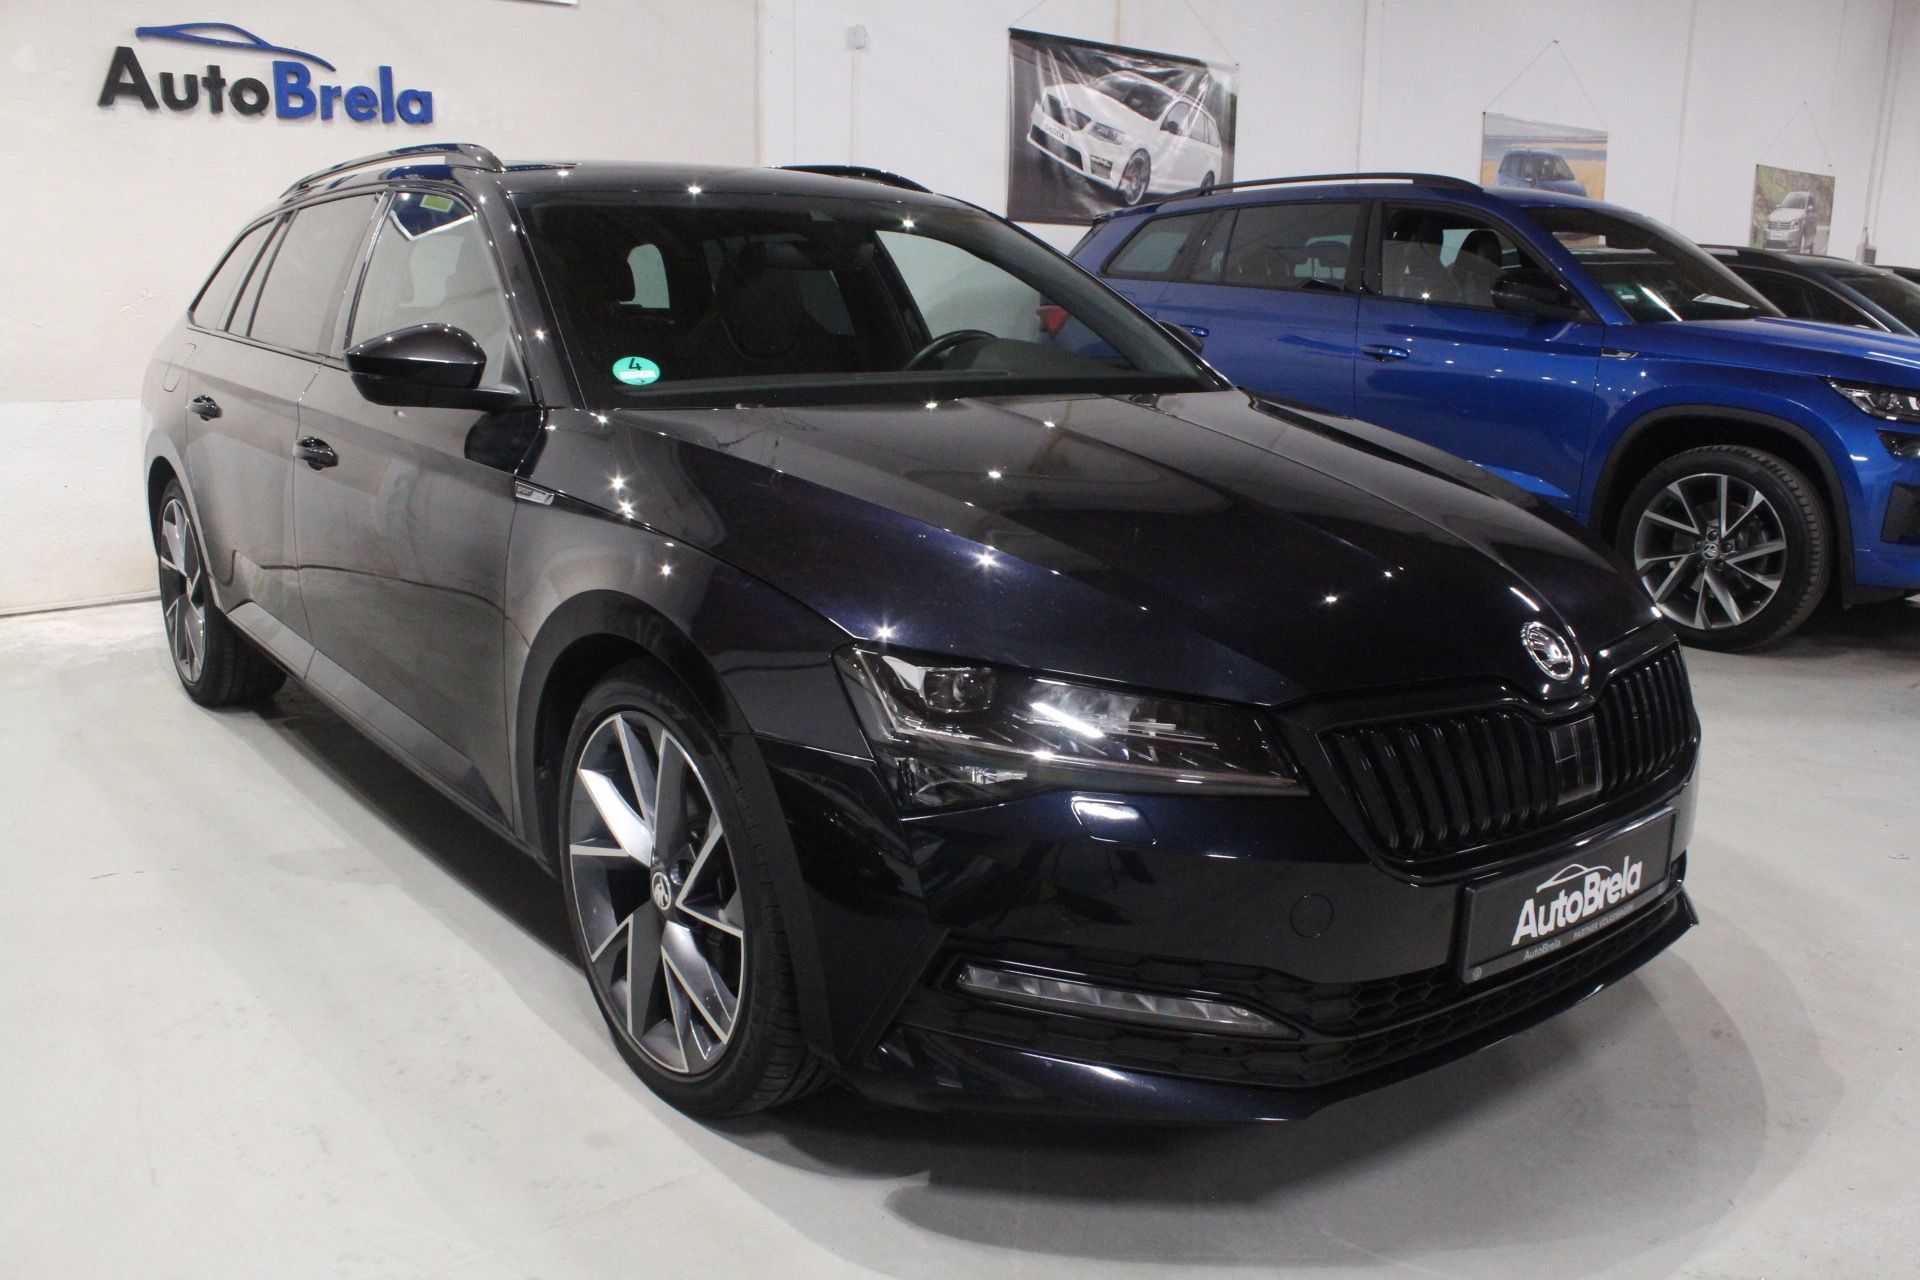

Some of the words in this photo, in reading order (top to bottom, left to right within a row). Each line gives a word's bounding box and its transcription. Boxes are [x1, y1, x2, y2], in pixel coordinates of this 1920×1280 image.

[97, 46, 433, 124] AutoBrela
[628, 358, 642, 370] 4
[1511, 855, 1643, 945] AutoBrela
[1523, 939, 1561, 960] AutoBrela
